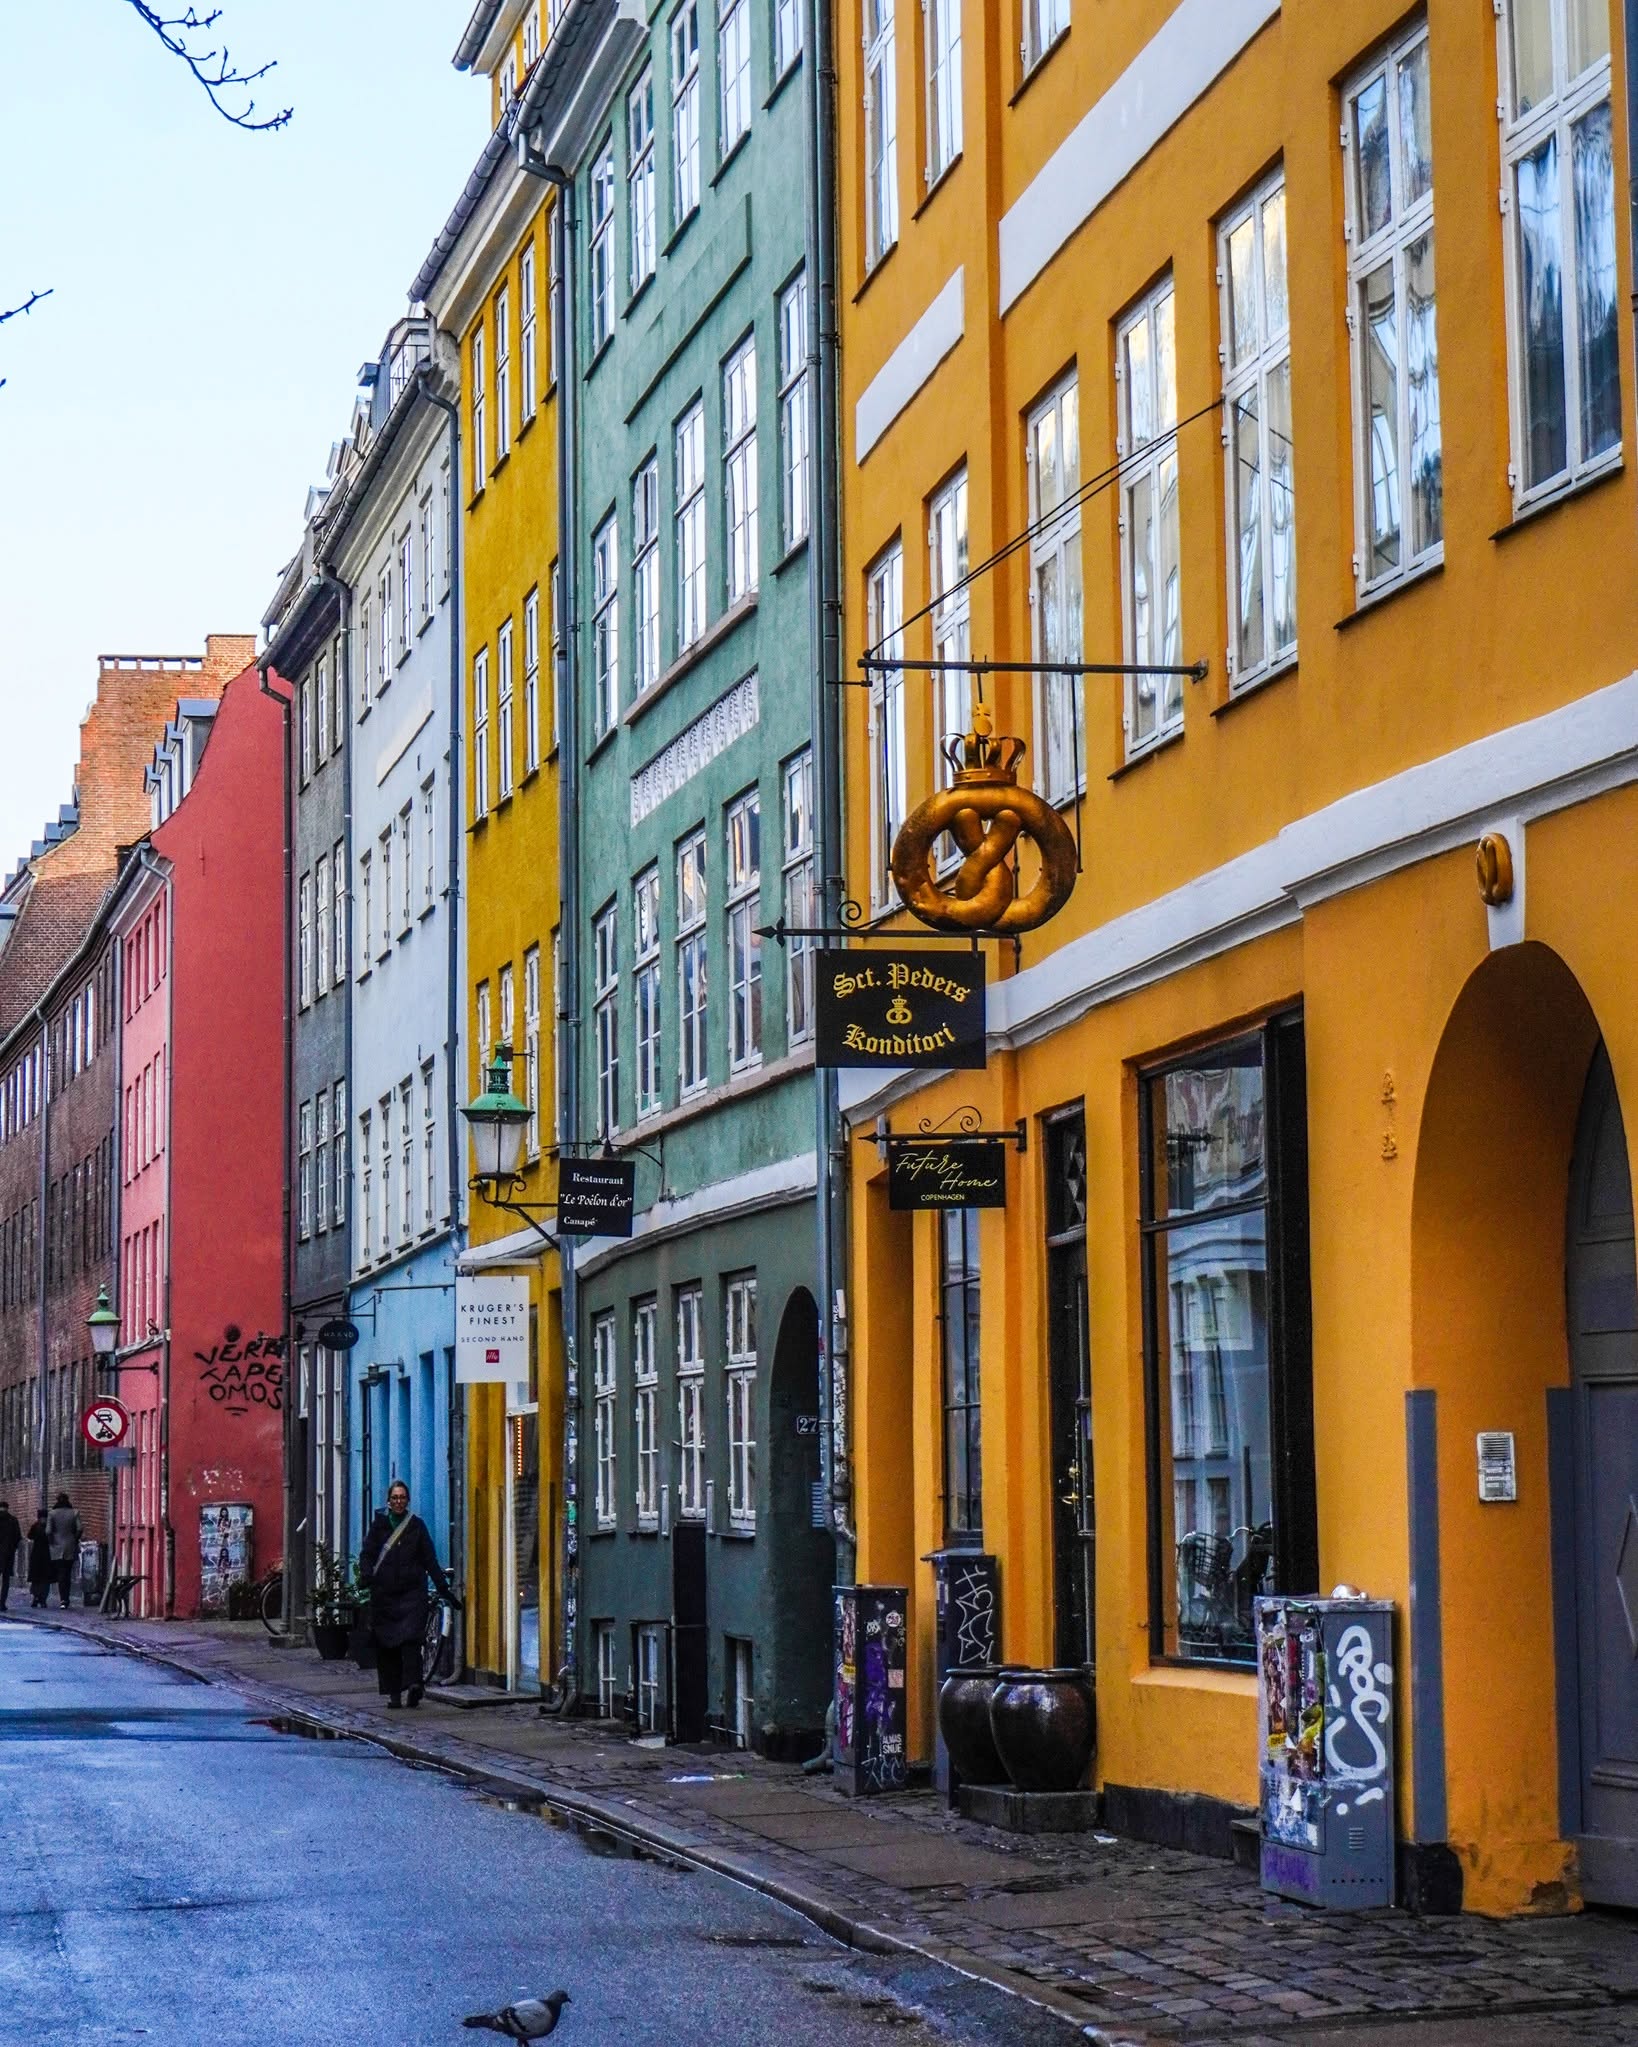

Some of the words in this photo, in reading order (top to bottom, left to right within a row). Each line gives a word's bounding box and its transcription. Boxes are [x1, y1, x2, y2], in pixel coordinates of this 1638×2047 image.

[833, 967, 881, 999] Sct.
[887, 963, 971, 1003] Peders
[842, 1023, 956, 1055] Konditori
[895, 1149, 963, 1181] Future
[572, 1172, 624, 1185] Restaurant
[939, 1171, 998, 1191] Home
[920, 1193, 965, 1201] COPENHAGEN
[460, 1303, 524, 1313] KRUGER'S
[469, 1316, 516, 1325] FINEST
[800, 1417, 818, 1433] 27
